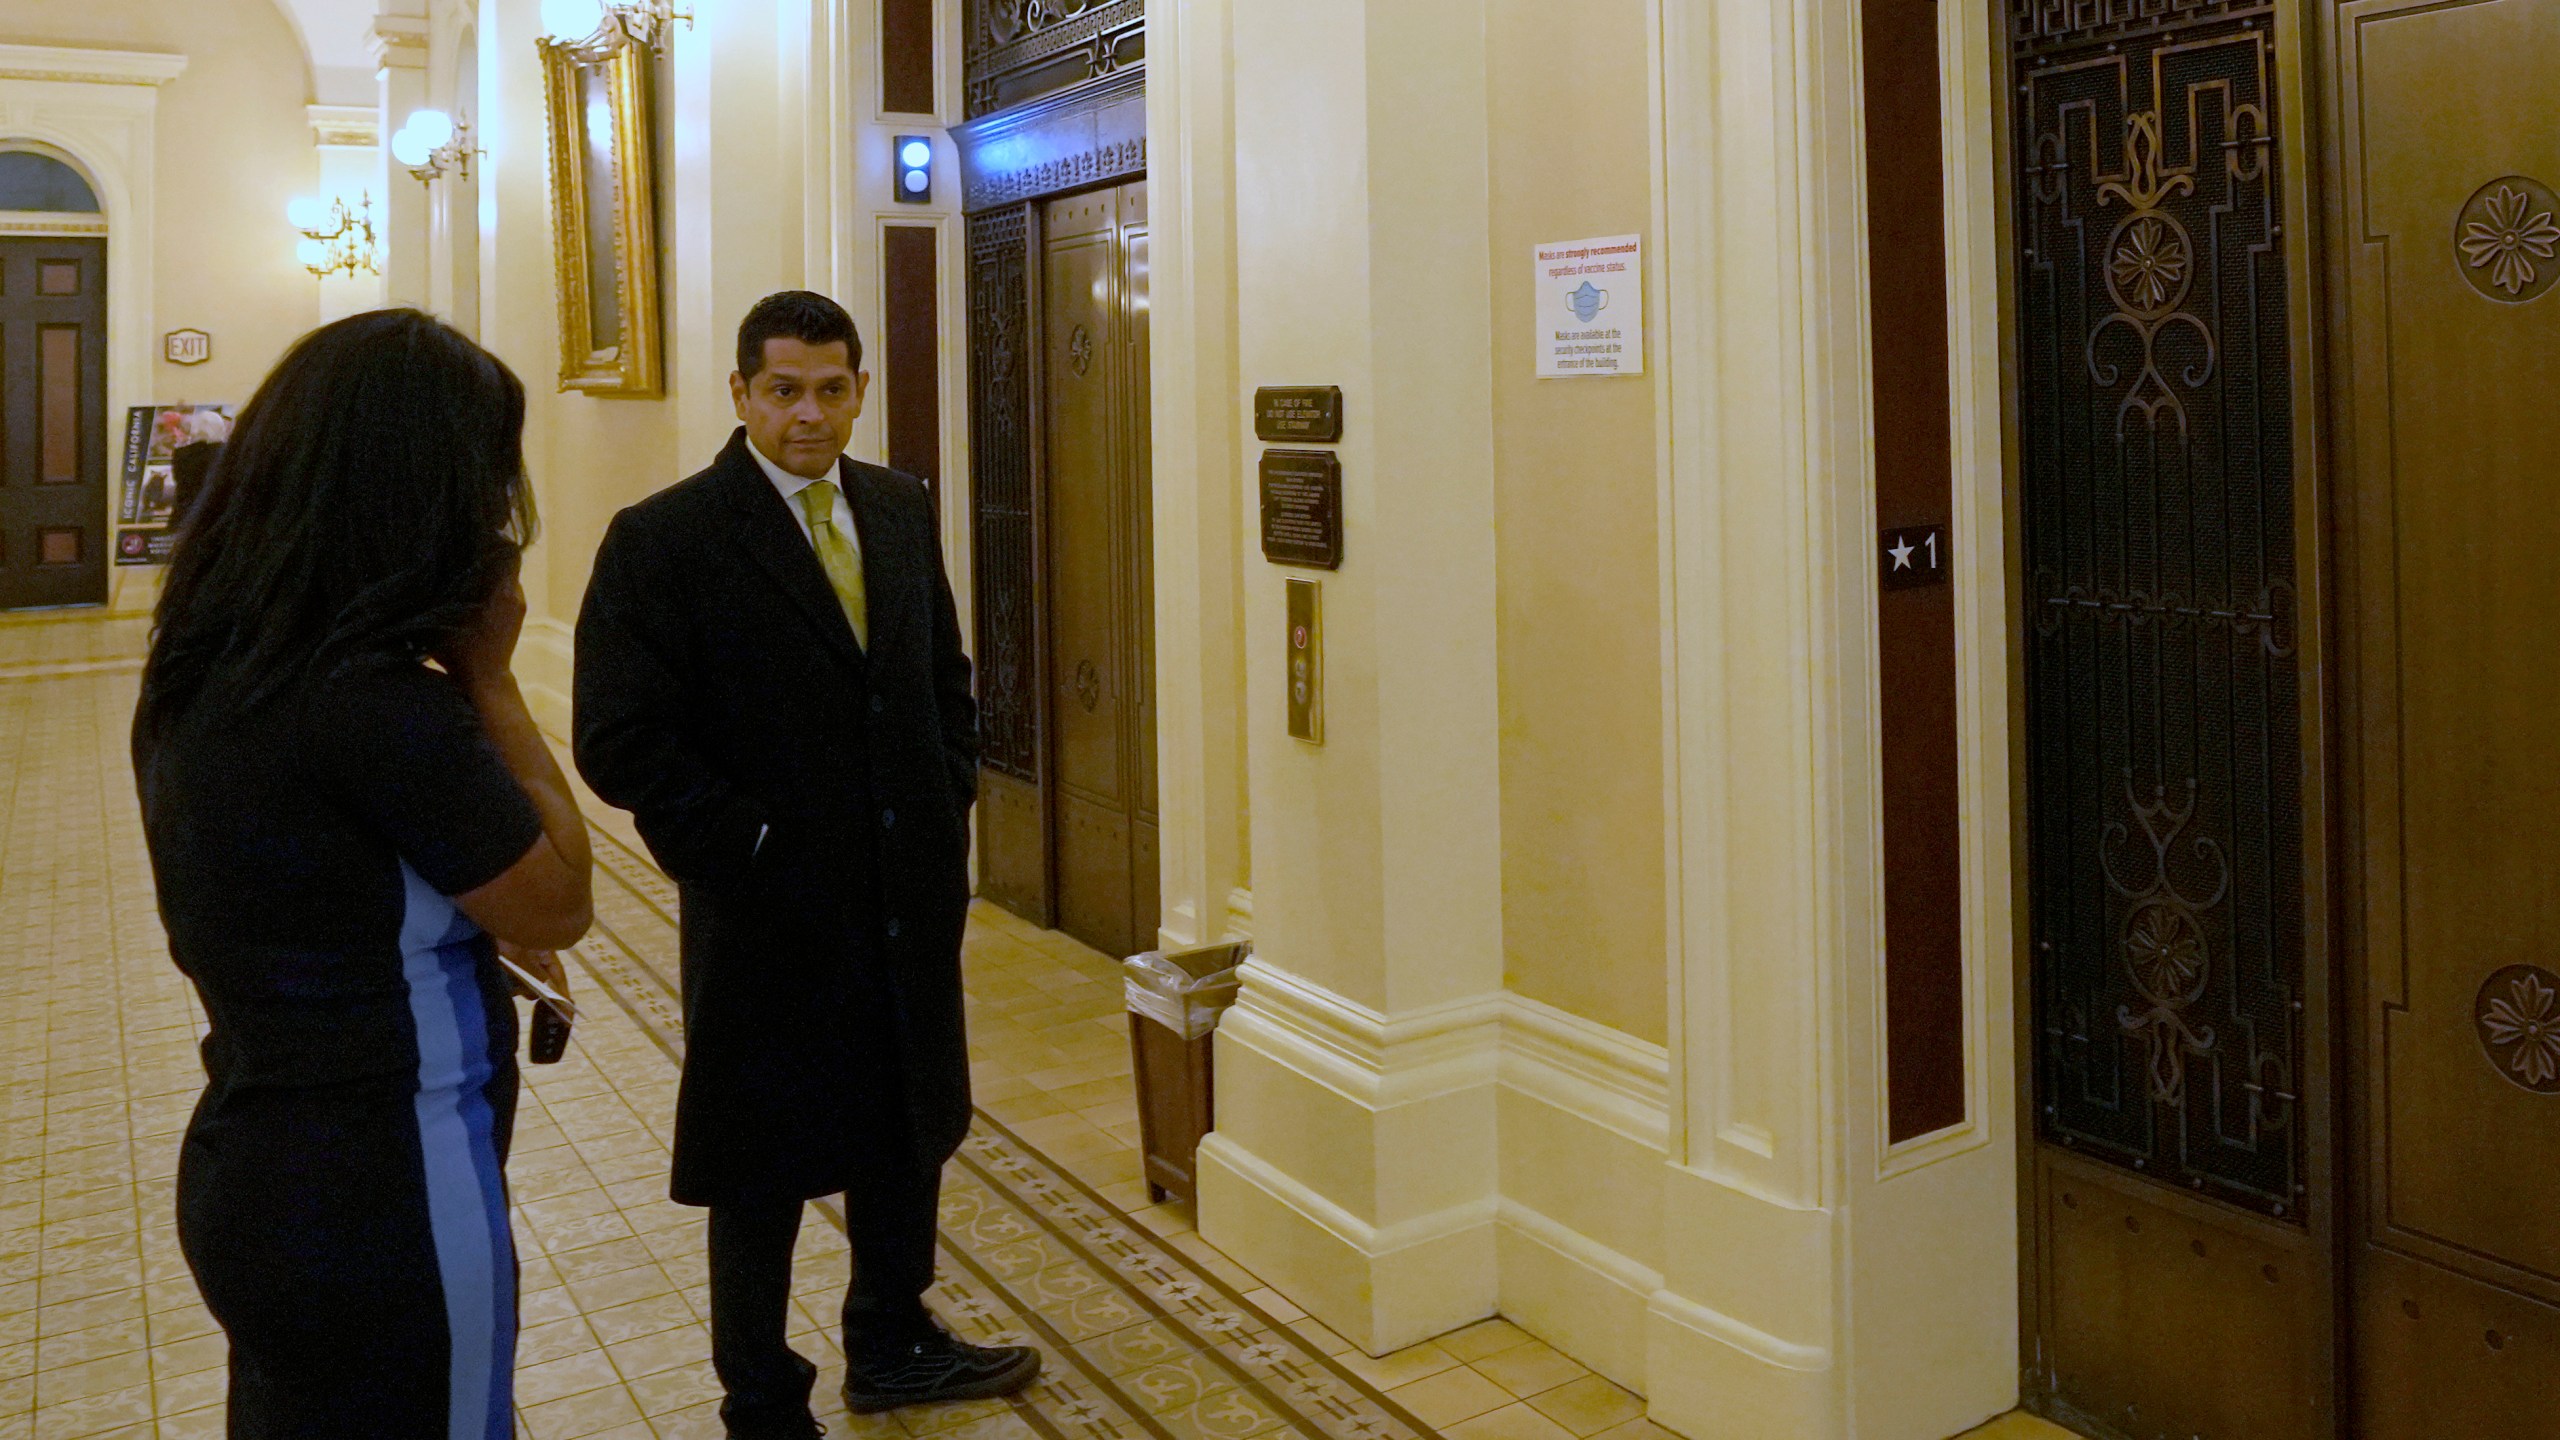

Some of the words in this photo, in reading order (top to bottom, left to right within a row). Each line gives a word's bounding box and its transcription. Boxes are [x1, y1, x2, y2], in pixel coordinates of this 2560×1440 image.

[1539, 250, 1555, 261] Masks
[1556, 250, 1565, 259] are
[1565, 247, 1589, 259] strongly
[1590, 242, 1637, 256] recommended
[1548, 265, 1576, 279] regardless
[1577, 264, 1584, 275] of
[1584, 263, 1605, 273] vaccine
[1555, 330, 1570, 341] Masks
[1571, 331, 1580, 340] are
[1580, 329, 1604, 340] available
[1605, 329, 1611, 339] at
[1612, 328, 1621, 339] the
[170, 337, 205, 356] EXIT
[1612, 343, 1622, 353] the
[128, 411, 141, 473] CALIFORNIA
[123, 480, 136, 518] ICONIC
[1924, 531, 1936, 569] 1
